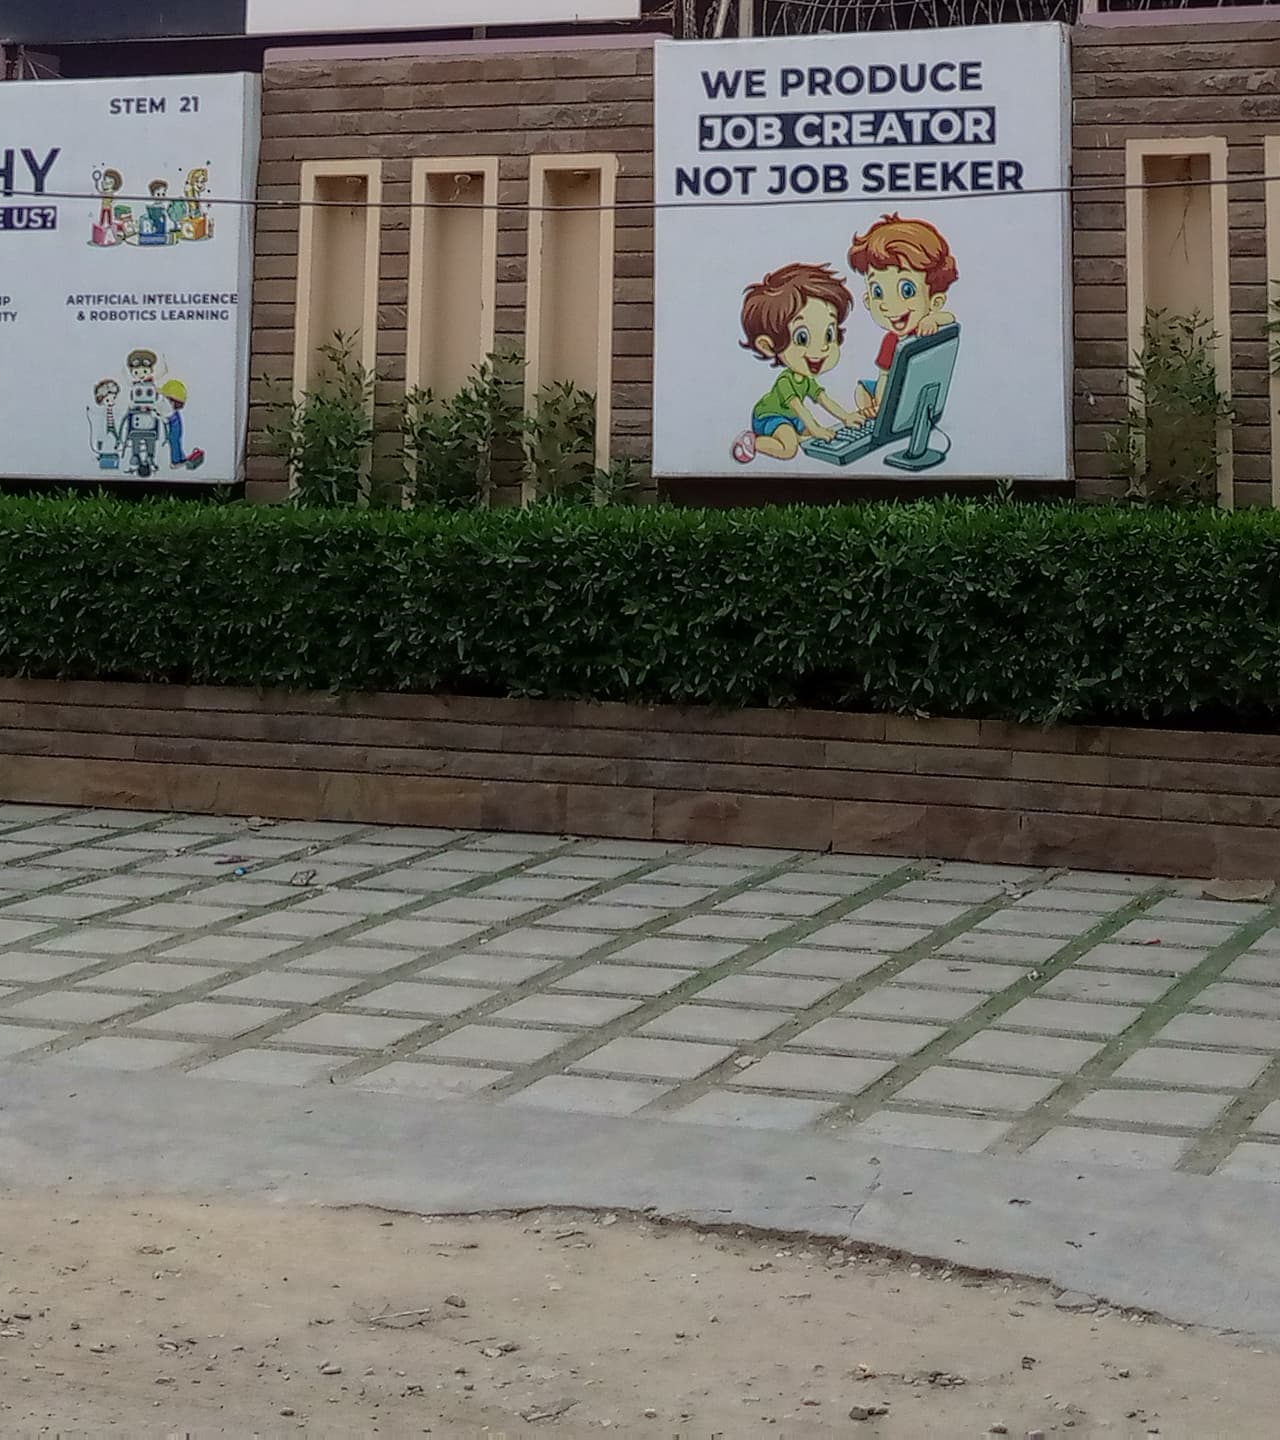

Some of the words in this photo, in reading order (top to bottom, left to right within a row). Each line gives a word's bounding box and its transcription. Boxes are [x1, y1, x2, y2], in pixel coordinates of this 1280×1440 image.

[701, 69, 766, 99] WE
[780, 61, 983, 97] PRODUCE
[109, 97, 167, 115] STEM
[179, 96, 200, 114] 21
[701, 114, 784, 150] JOB
[794, 110, 993, 147] CREATOR
[675, 165, 758, 197] NOT
[767, 164, 849, 194] JOB
[861, 160, 1025, 193] SEEKER
[11, 206, 56, 229] US?
[66, 294, 139, 306] ARTIFICIAL
[143, 293, 239, 306] INTELLIGENCE
[76, 309, 85, 321] &
[89, 308, 157, 321] ROBOTICS
[161, 307, 229, 321] LEARNING
